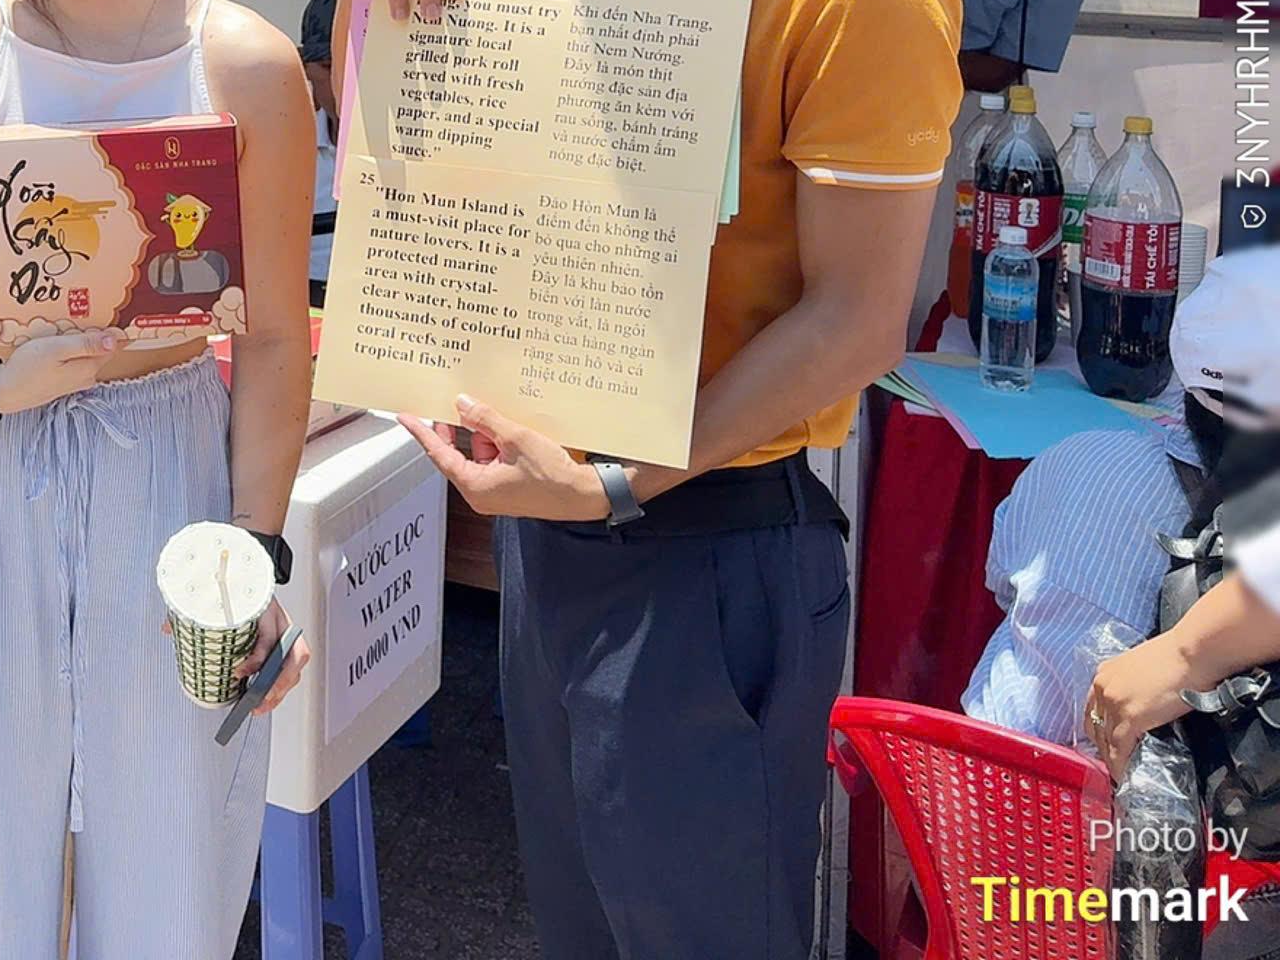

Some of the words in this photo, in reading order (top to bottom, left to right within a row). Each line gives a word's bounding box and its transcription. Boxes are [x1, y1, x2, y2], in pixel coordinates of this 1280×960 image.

[463, 0, 492, 12] you
[497, 2, 533, 16] must
[538, 6, 561, 21] try
[573, 5, 599, 19] Khi
[632, 10, 662, 25] Nha
[667, 14, 713, 33] Trang,
[447, 14, 497, 32] Nuong.
[503, 20, 516, 33] It
[521, 21, 532, 35] is
[537, 26, 545, 35] a
[409, 31, 472, 48] signature
[477, 36, 512, 51] local
[632, 29, 665, 46] định
[405, 50, 449, 64] grilled
[453, 55, 488, 68] pork
[493, 59, 519, 71] roll
[594, 42, 628, 58] Nem
[402, 70, 446, 83] served
[451, 72, 481, 86] with
[486, 75, 524, 92] fresh
[613, 64, 644, 79] món
[649, 67, 674, 83] thịt
[400, 88, 474, 106] vegetables,
[479, 95, 507, 110] rice
[665, 88, 688, 104] địa
[397, 106, 440, 121] paper,
[444, 112, 471, 125] and
[475, 117, 483, 125] a
[488, 117, 540, 133] special
[671, 108, 696, 122] với
[395, 125, 433, 139] warm
[437, 127, 493, 149] dipping
[622, 119, 657, 136] bánh
[359, 172, 375, 185] 25
[421, 191, 456, 209] Mun
[462, 197, 508, 215] Island
[513, 203, 525, 217] is
[606, 203, 640, 220] Mun
[372, 207, 380, 218] a
[385, 208, 459, 229] must-visit
[463, 218, 503, 235] place
[508, 224, 531, 239] for
[370, 227, 419, 243] nature
[424, 232, 473, 251] lovers.
[479, 240, 490, 253] It
[495, 241, 507, 257] is
[512, 247, 520, 257] a
[585, 241, 611, 255] cho
[664, 250, 678, 263] ai
[367, 247, 438, 266] protected
[443, 257, 498, 275] marine
[364, 266, 398, 280] area
[403, 270, 436, 286] with
[440, 276, 499, 295] crystal-
[362, 283, 400, 300] clear
[405, 290, 452, 309] water,
[457, 297, 499, 316] home
[503, 307, 518, 319] to
[360, 302, 437, 326] thousands
[441, 317, 457, 329] of
[461, 320, 521, 340] colorful
[357, 324, 396, 339] coral
[400, 330, 437, 346] reefs
[441, 338, 471, 352] and
[354, 341, 414, 363] tropical
[419, 351, 462, 369] fish."
[346, 541, 391, 596] NƯỚC
[395, 513, 425, 557] LỌC
[360, 568, 413, 629] WATER
[348, 632, 389, 687] 10.000
[391, 604, 421, 644] VND
